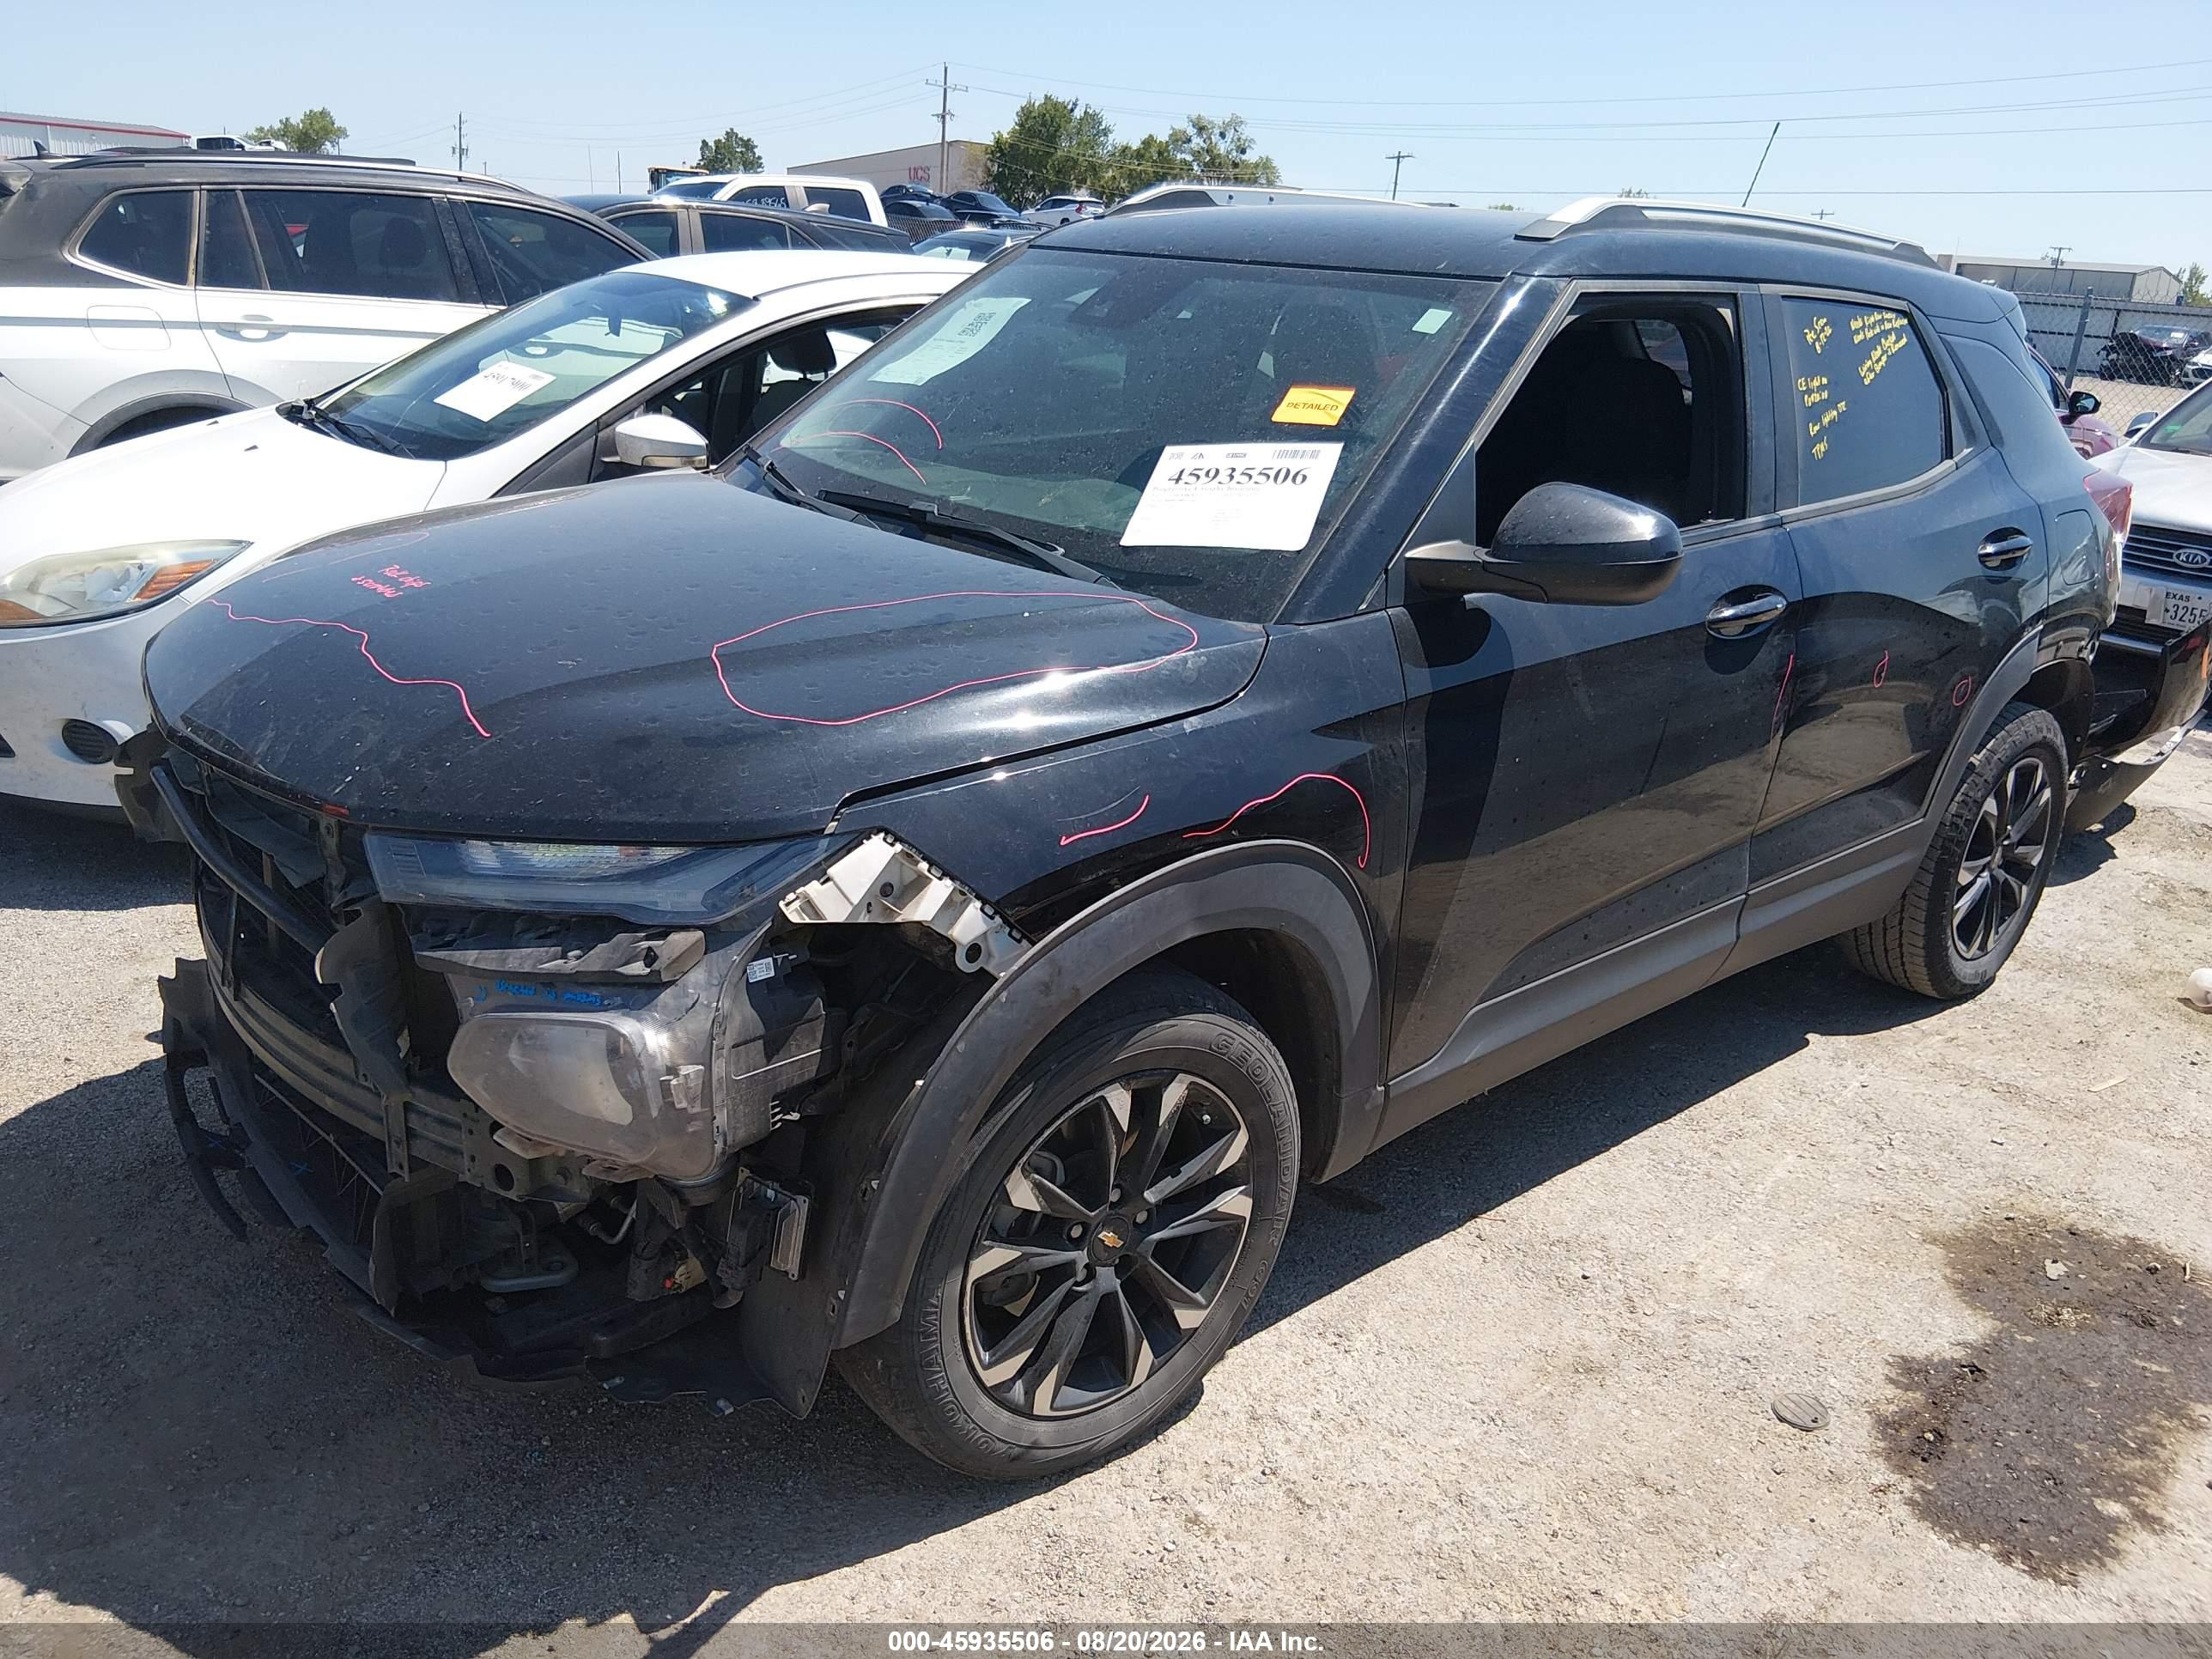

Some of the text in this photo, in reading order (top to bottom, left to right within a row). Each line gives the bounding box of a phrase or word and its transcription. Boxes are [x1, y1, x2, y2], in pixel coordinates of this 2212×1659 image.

[908, 165, 931, 183] UCS
[1285, 402, 1340, 411] DETAILED
[1168, 466, 1312, 486] 45935506
[2179, 551, 2203, 564] KIA
[2165, 591, 2191, 602] EXAS
[1210, 1033, 1293, 1247] GEOLANDAR
